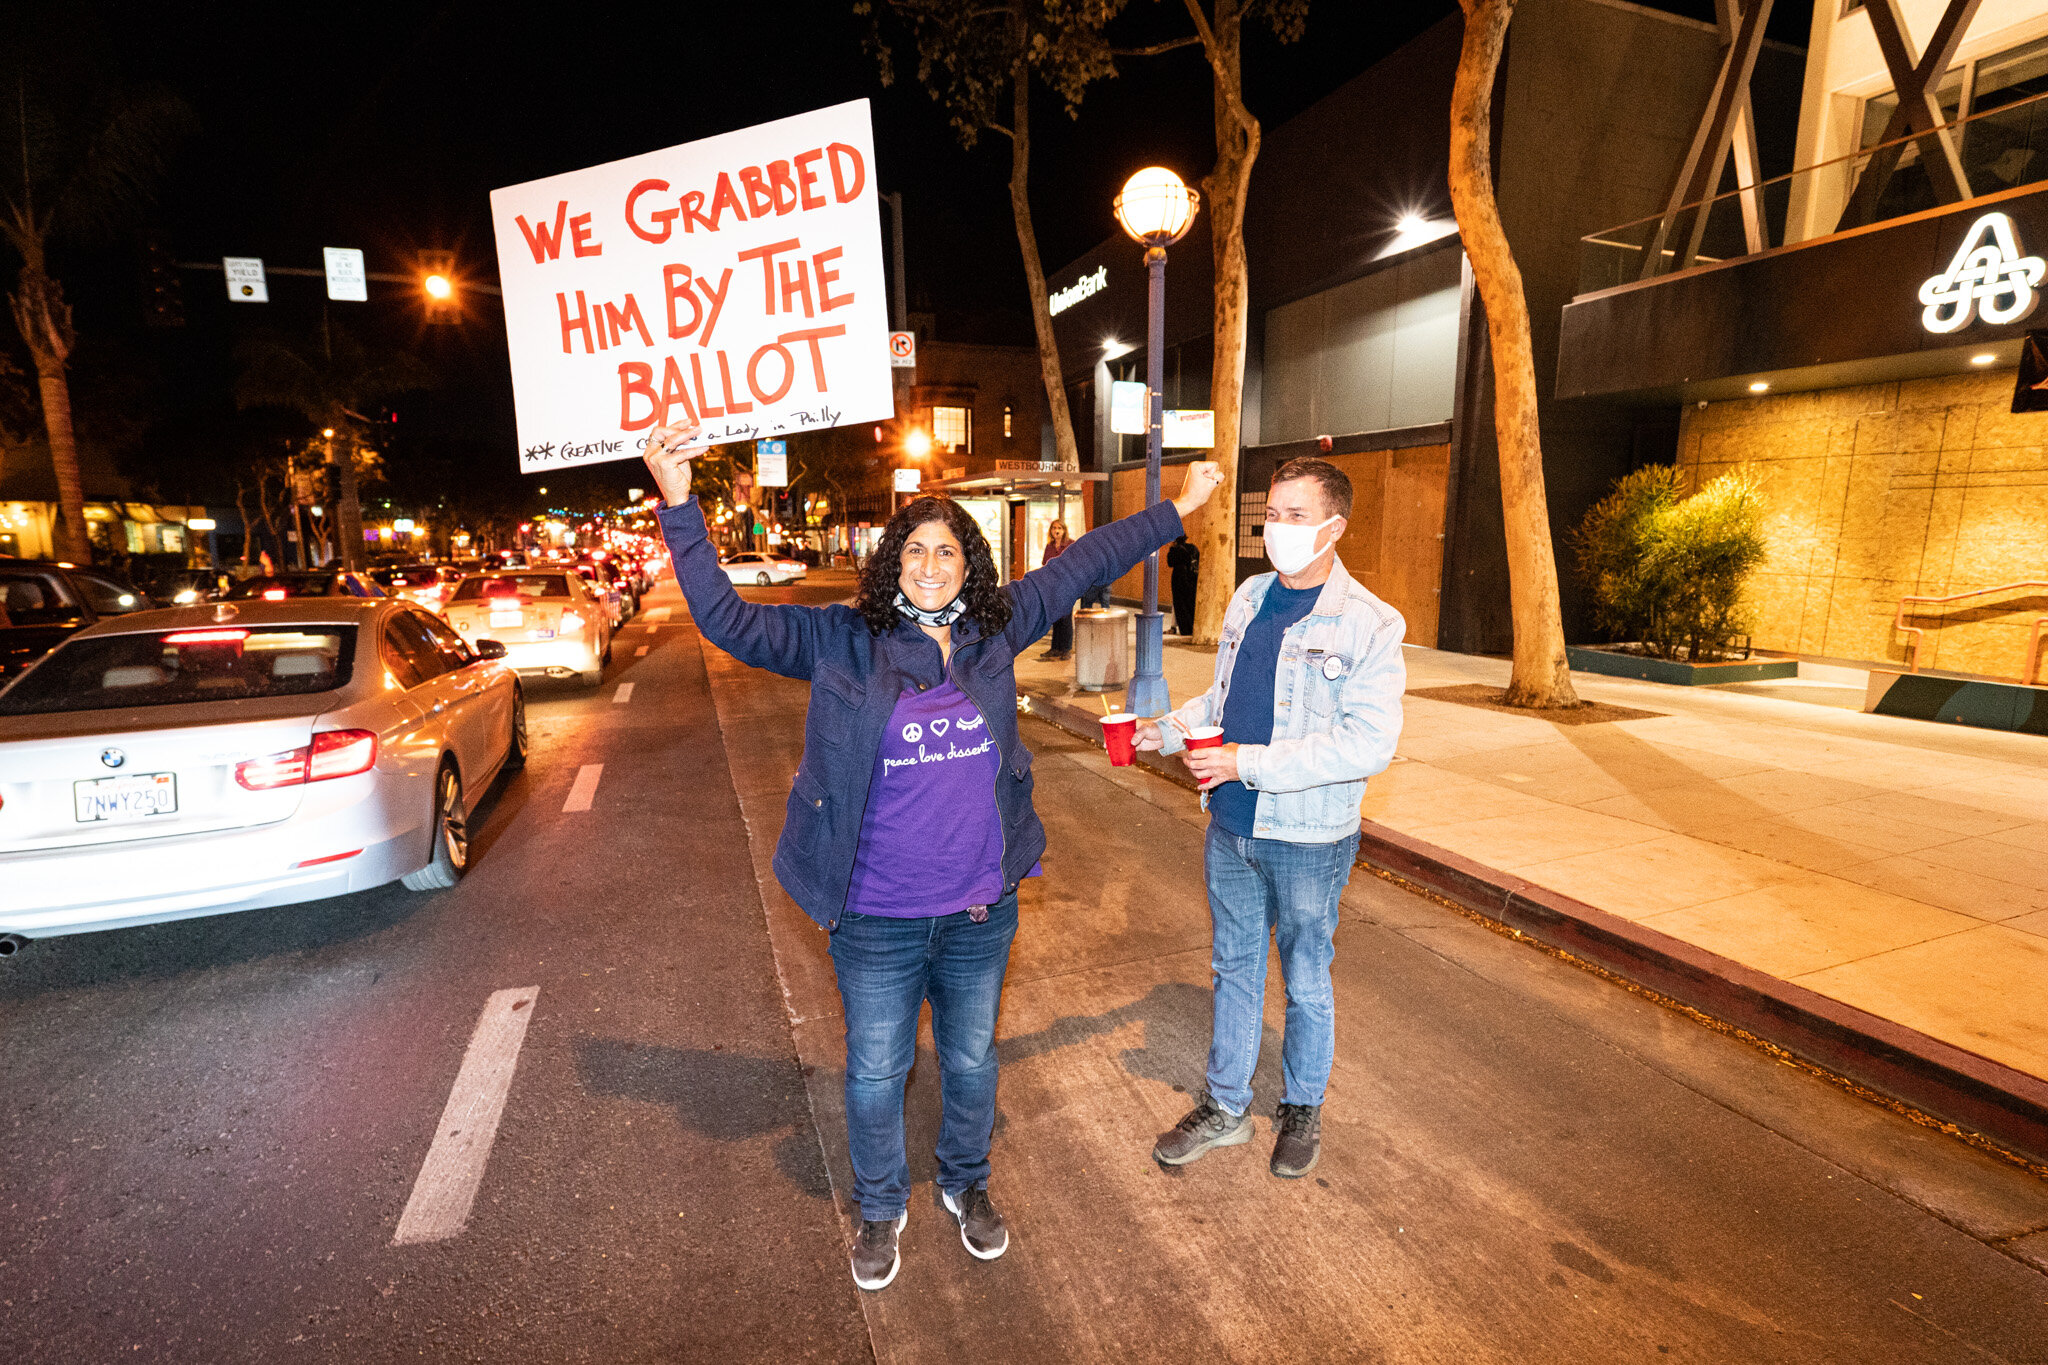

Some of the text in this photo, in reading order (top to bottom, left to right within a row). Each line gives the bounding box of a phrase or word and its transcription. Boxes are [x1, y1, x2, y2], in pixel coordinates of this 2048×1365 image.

[515, 142, 866, 264] WE GRABBED
[556, 237, 855, 354] HIM BY THE
[1049, 265, 1108, 317] UnionBank
[617, 324, 847, 432] BALLOT
[560, 439, 625, 460] CREATIVE
[725, 424, 760, 439] Lady
[773, 423, 786, 431] in
[790, 405, 842, 428] Philly
[999, 461, 1077, 472] WESTBOURNE Dr
[883, 737, 995, 777] peace love dissent
[82, 789, 168, 814] 7NWY250
